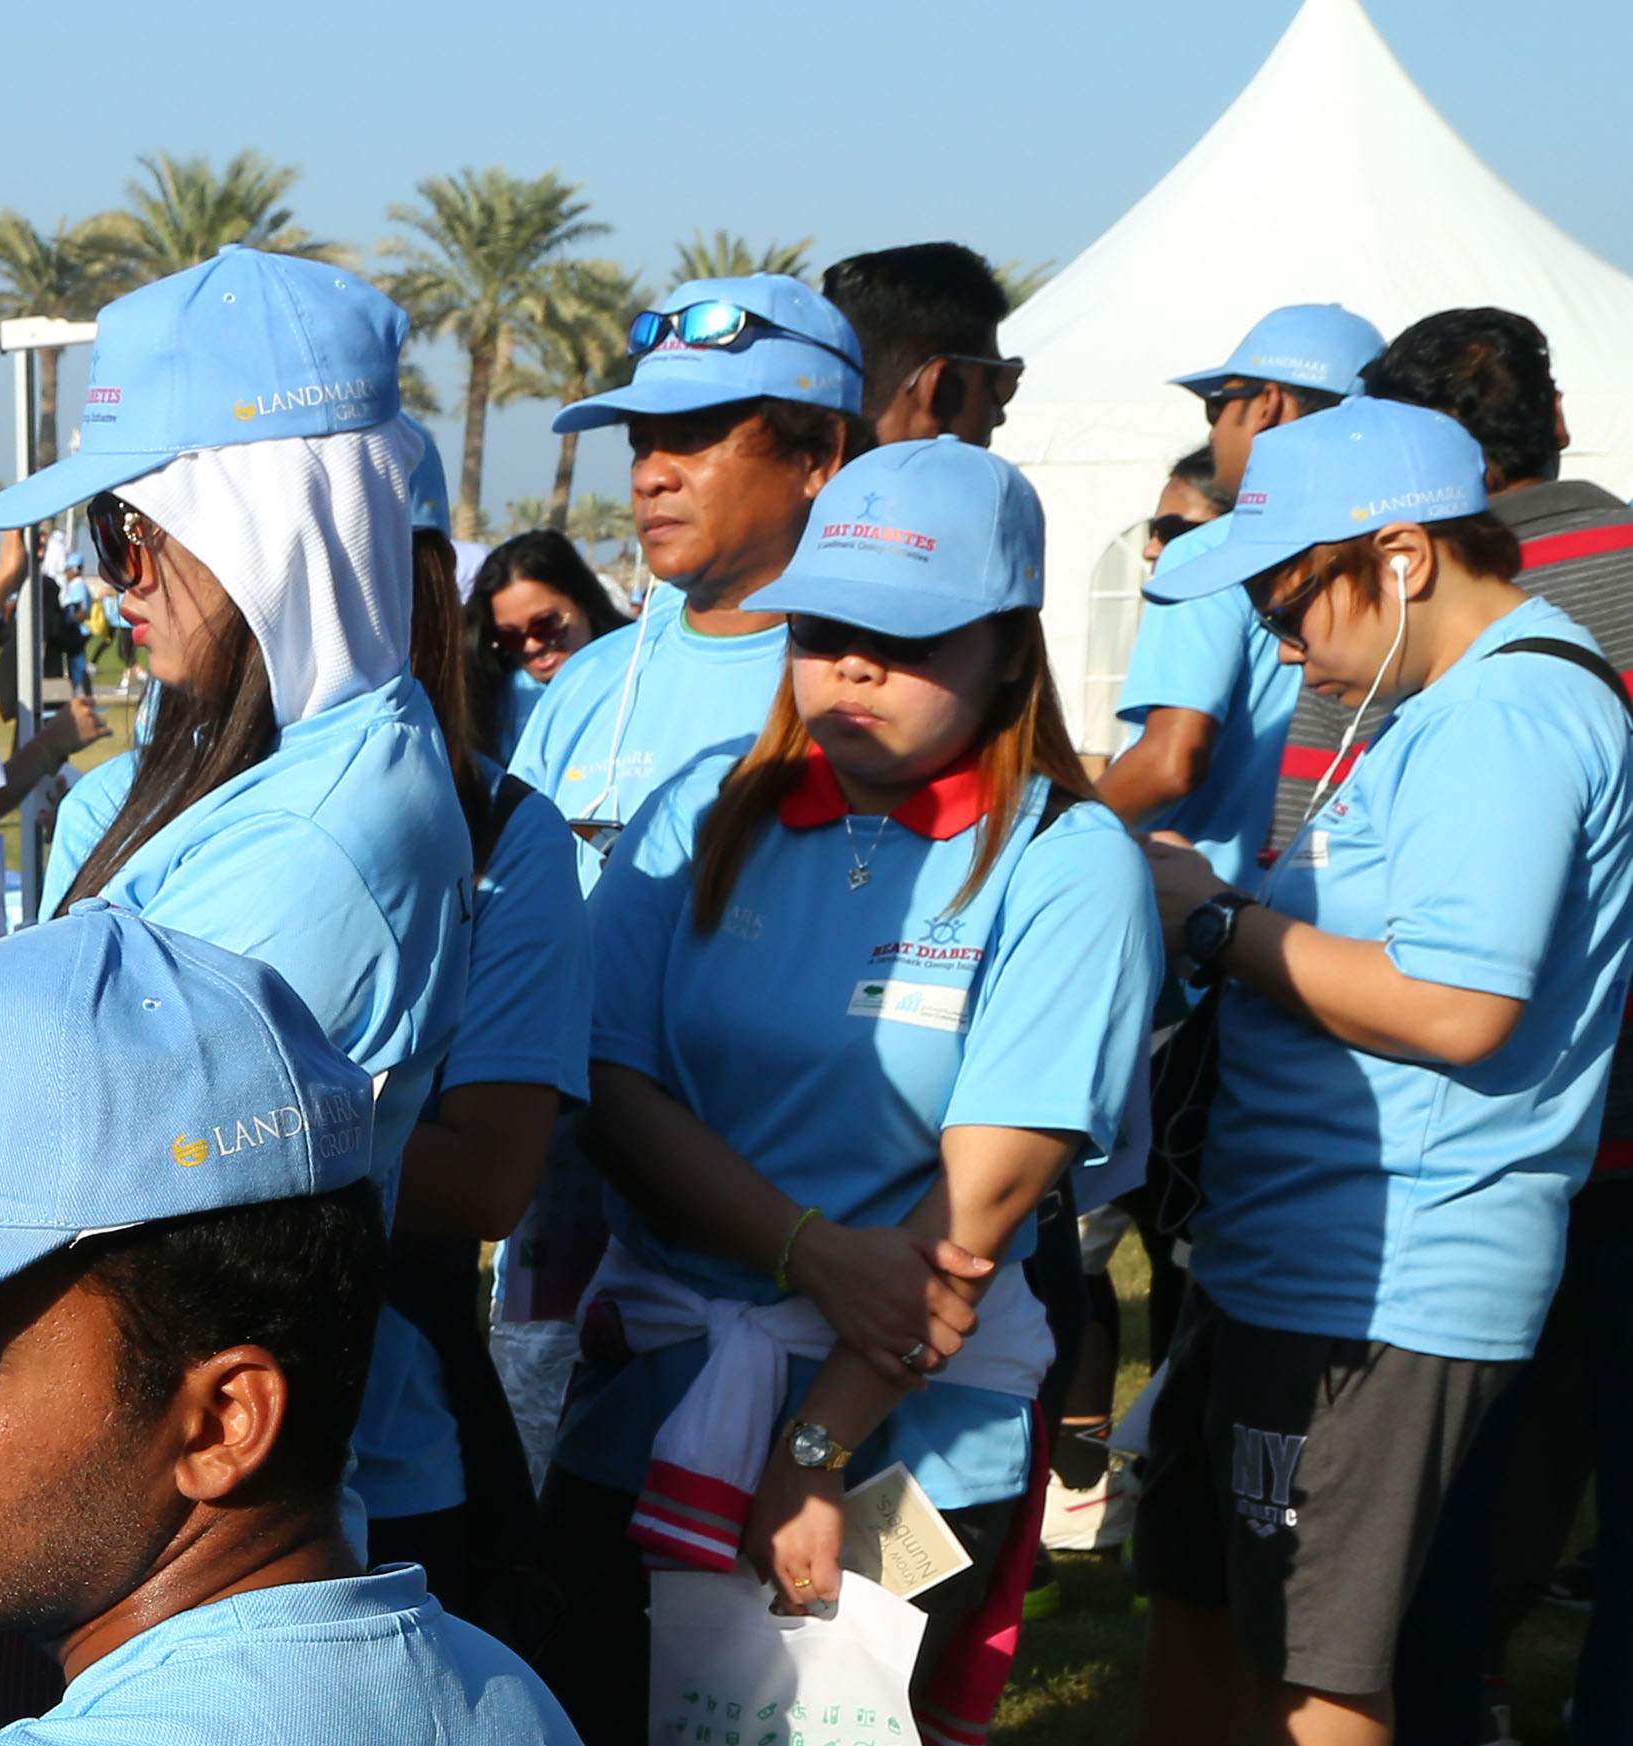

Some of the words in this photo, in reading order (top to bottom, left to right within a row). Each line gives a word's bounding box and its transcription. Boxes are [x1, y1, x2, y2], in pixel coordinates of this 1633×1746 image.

[335, 402, 373, 422] GRO
[1367, 486, 1467, 516] LANDMARK
[851, 523, 938, 552] DIABETES
[871, 941, 915, 958] BEAT
[916, 944, 985, 963] DIABET
[214, 1090, 361, 1157] LANDMARK
[1232, 1422, 1308, 1506] NY
[876, 1495, 939, 1580] Numbers.
